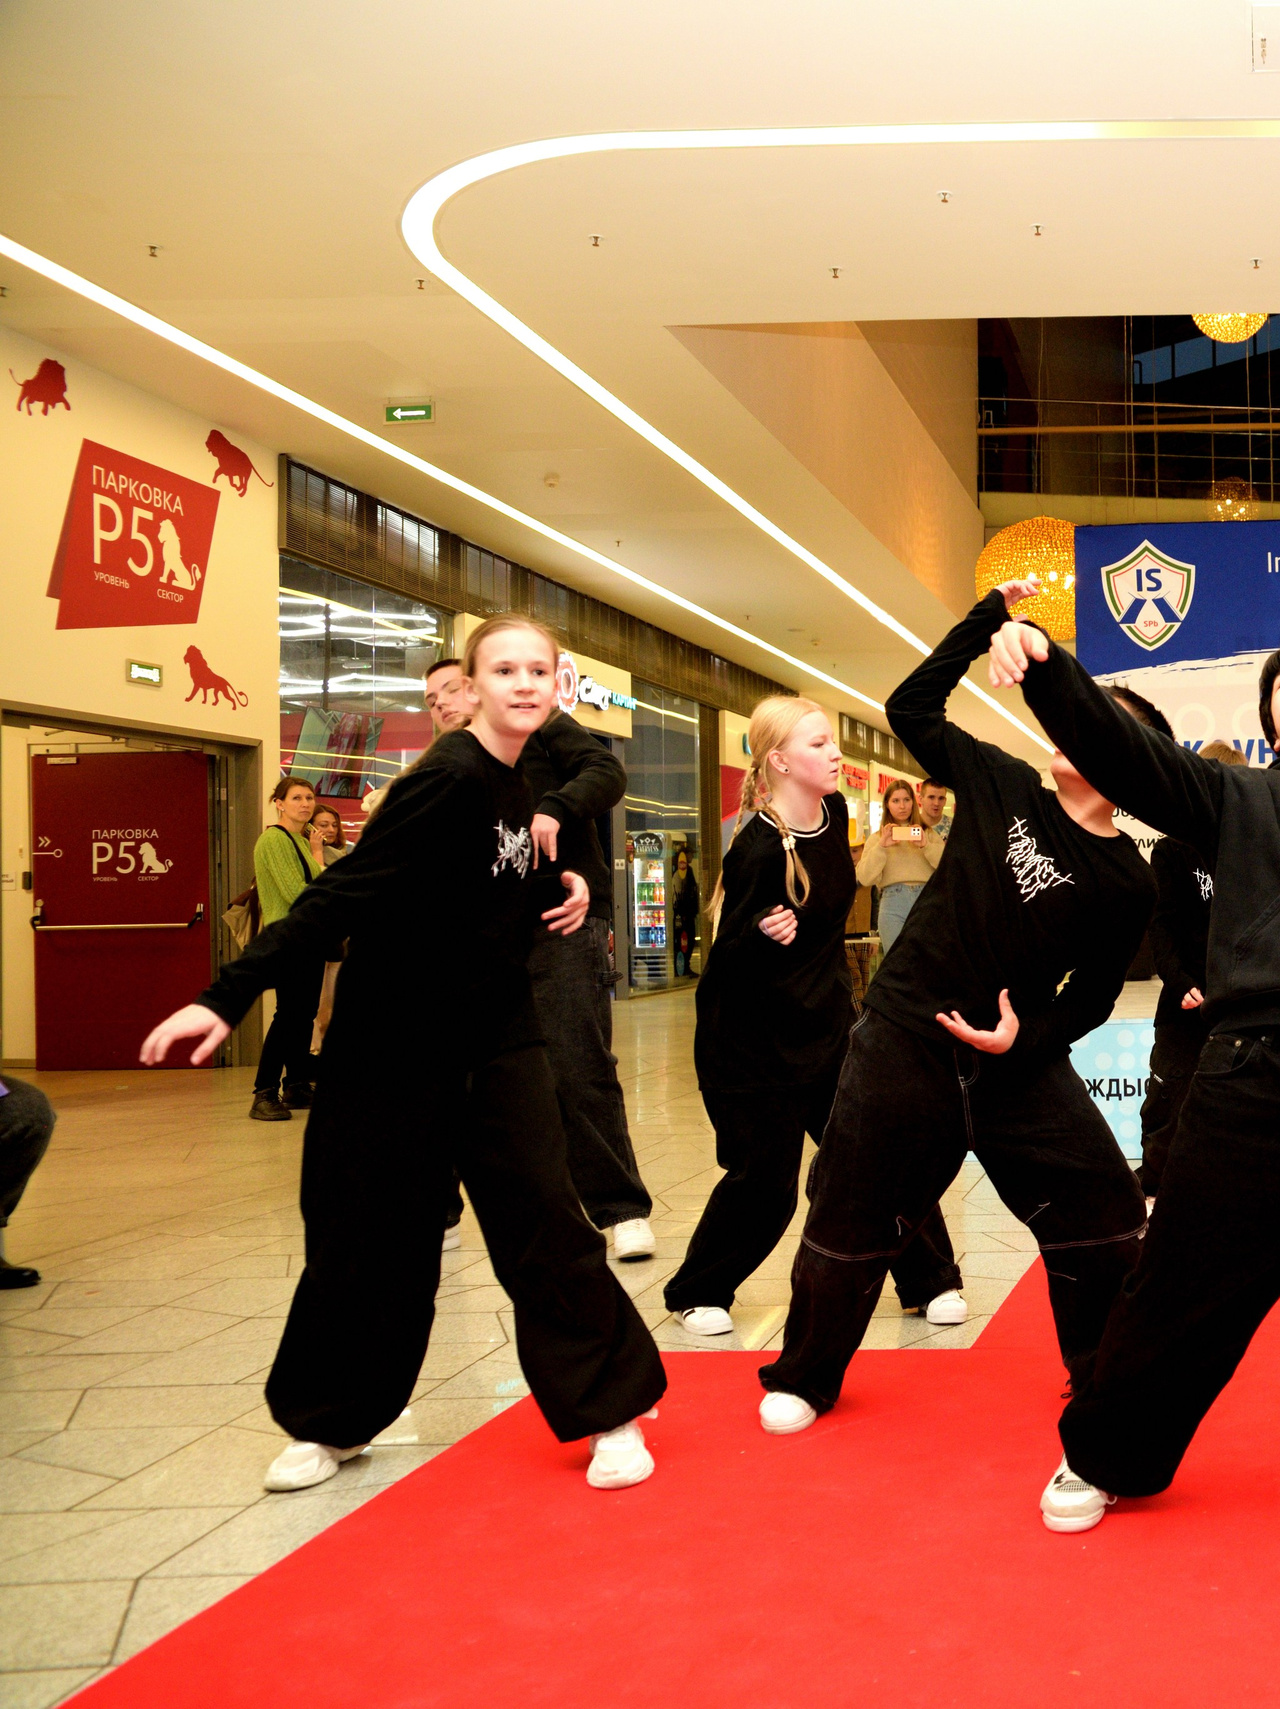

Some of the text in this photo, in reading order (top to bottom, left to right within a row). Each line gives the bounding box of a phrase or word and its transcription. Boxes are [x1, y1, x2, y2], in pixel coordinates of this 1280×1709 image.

[92, 464, 184, 517] ПАРКОВКА
[93, 492, 154, 577] P5
[93, 570, 184, 603] УРОВЕНЬ СЕКТОР
[1135, 567, 1163, 592] IS
[1143, 620, 1159, 628] SPb
[92, 829, 160, 840] ПАРКОВКА
[92, 841, 136, 875] P5
